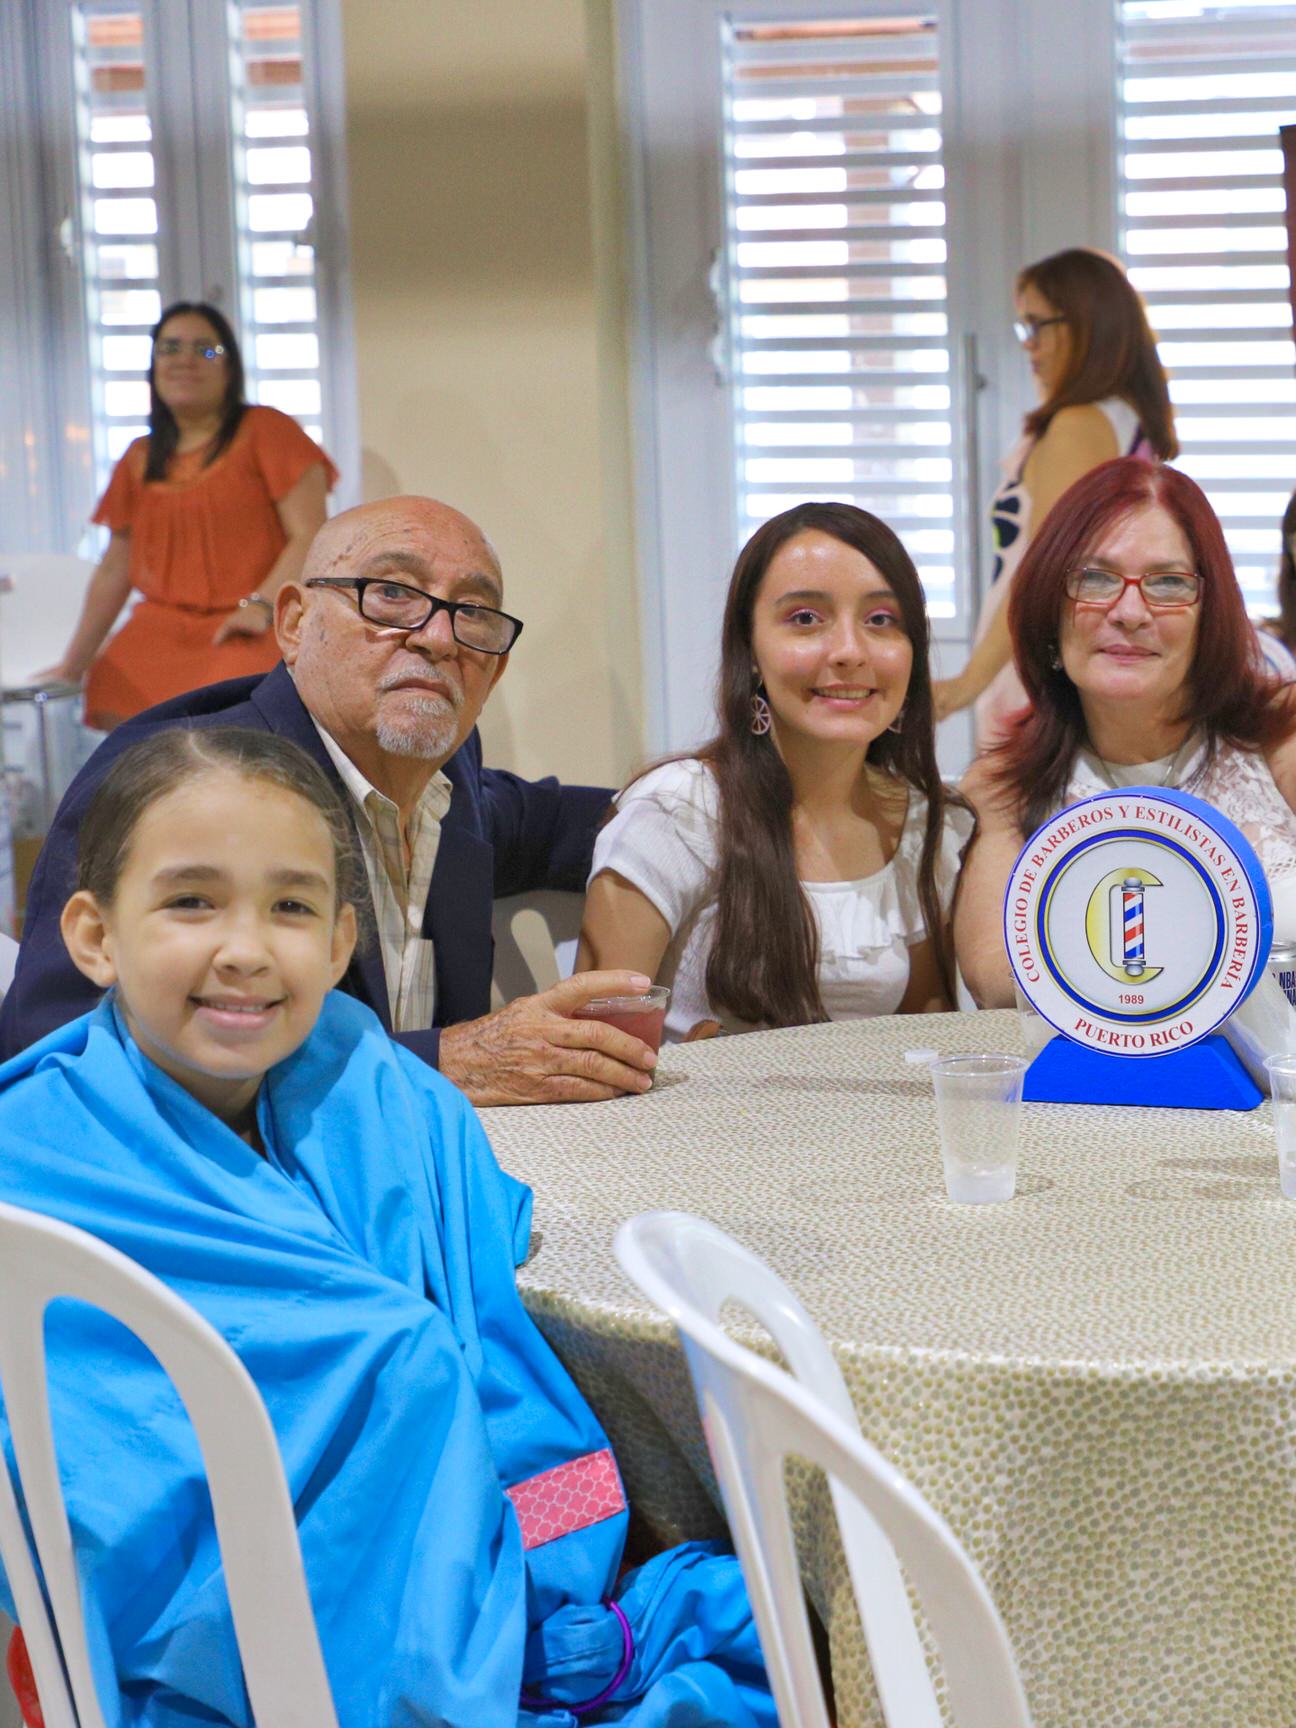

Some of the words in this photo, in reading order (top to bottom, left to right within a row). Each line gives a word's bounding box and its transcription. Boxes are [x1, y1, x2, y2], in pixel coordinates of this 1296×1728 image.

[1118, 806, 1131, 819] Y
[1031, 806, 1114, 868] BARBEROS
[1135, 807, 1226, 868] ESTILISTAS
[1020, 868, 1038, 896] DE
[1221, 860, 1244, 892] EN
[1014, 897, 1040, 983] COLEGIO
[1220, 897, 1248, 990] BARBERÍA
[1279, 969, 1296, 989] NBA
[1118, 994, 1144, 1005] 1989
[1074, 1018, 1145, 1048] PUERTO
[1150, 1020, 1194, 1047] RICO
